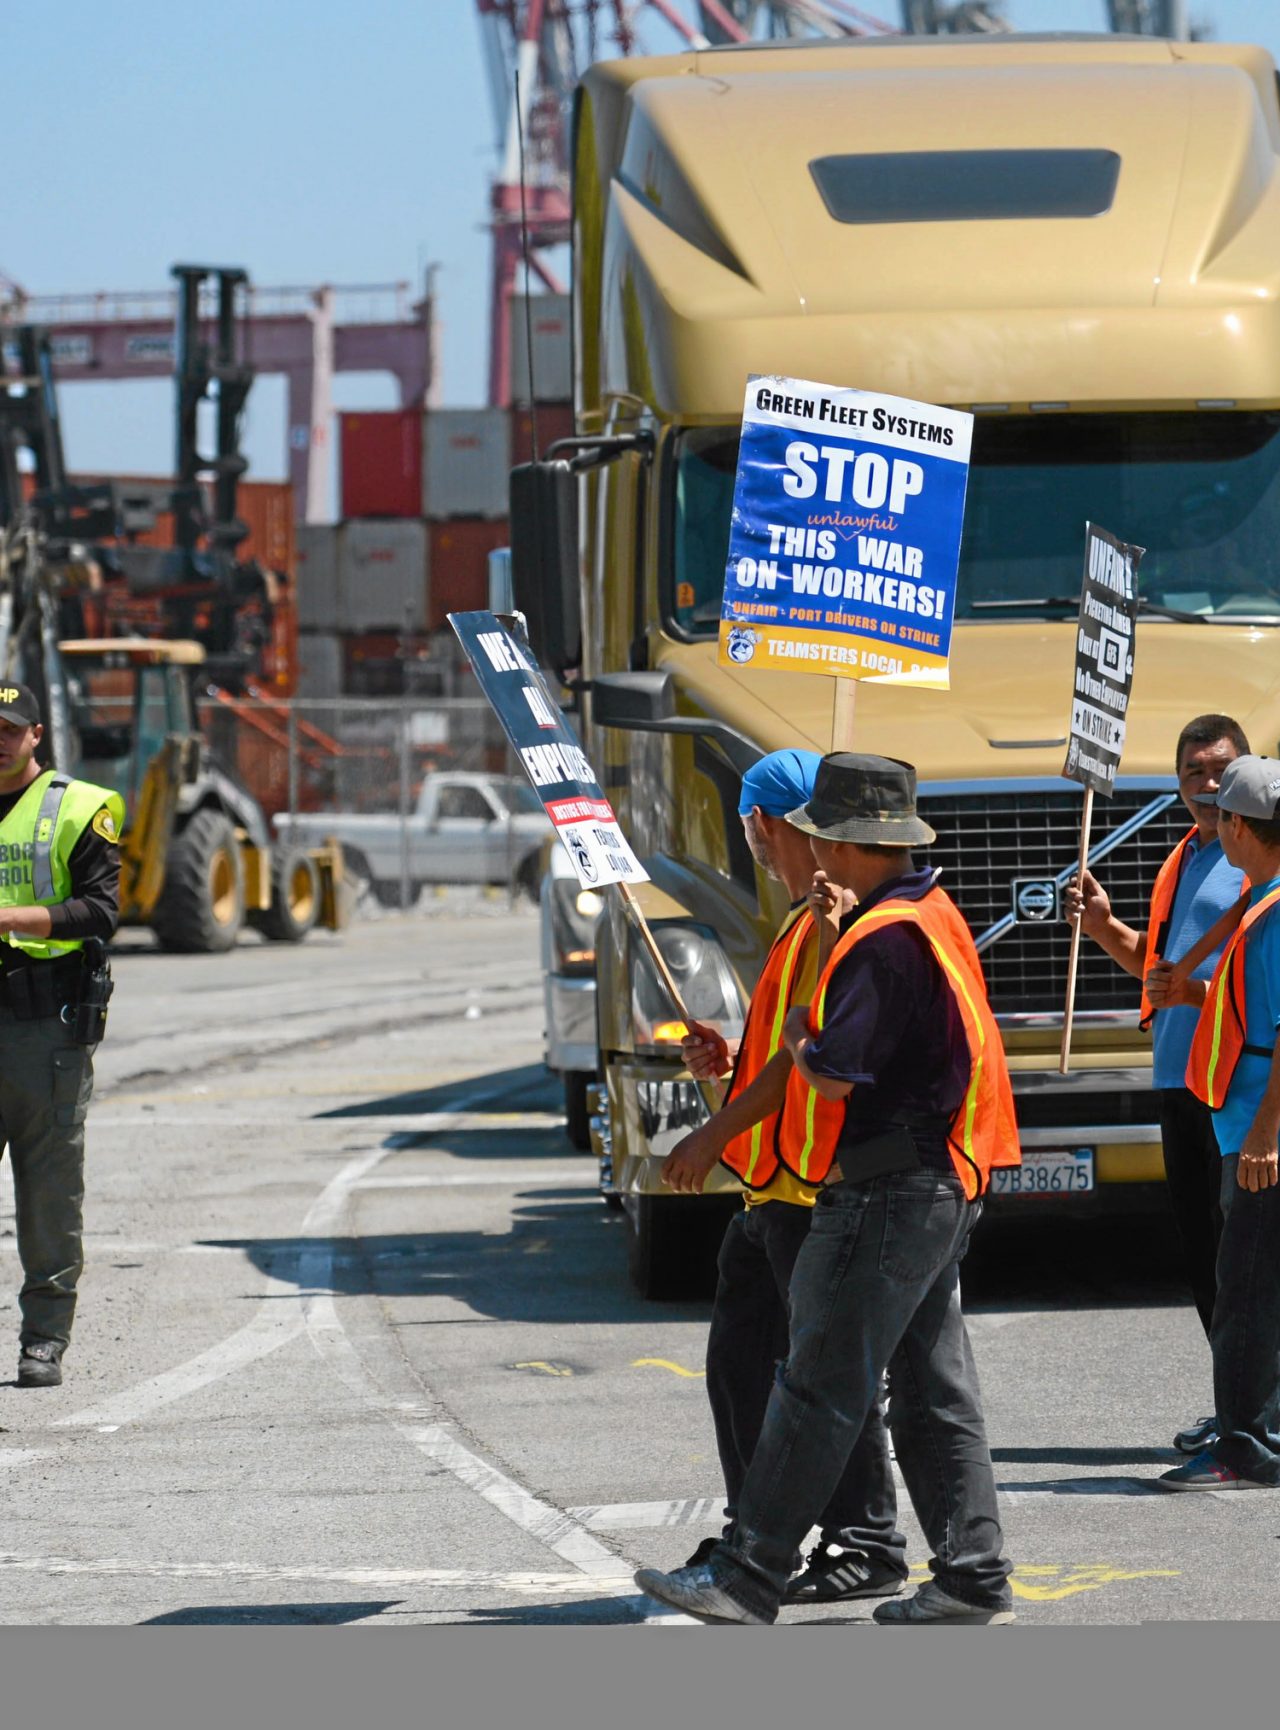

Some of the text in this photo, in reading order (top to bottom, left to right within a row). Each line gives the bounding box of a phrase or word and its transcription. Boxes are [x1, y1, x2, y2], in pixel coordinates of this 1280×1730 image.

[756, 388, 954, 446] GREEN FLEET SYSTEMS
[782, 441, 924, 514] STOP
[807, 510, 898, 531] unlawful
[767, 524, 924, 578] THIS WAR
[1088, 534, 1134, 600] UNFAIR!
[736, 557, 946, 620] ON WORKERS!
[733, 601, 941, 647] UNFAIR PORT DRIVERS ON STRIKE
[477, 632, 520, 672] WE
[767, 639, 858, 665] TEAMSTERS
[860, 651, 903, 674] LOCAL
[1082, 709, 1112, 745] ON STRIKE
[996, 1165, 1089, 1193] 9B38675
